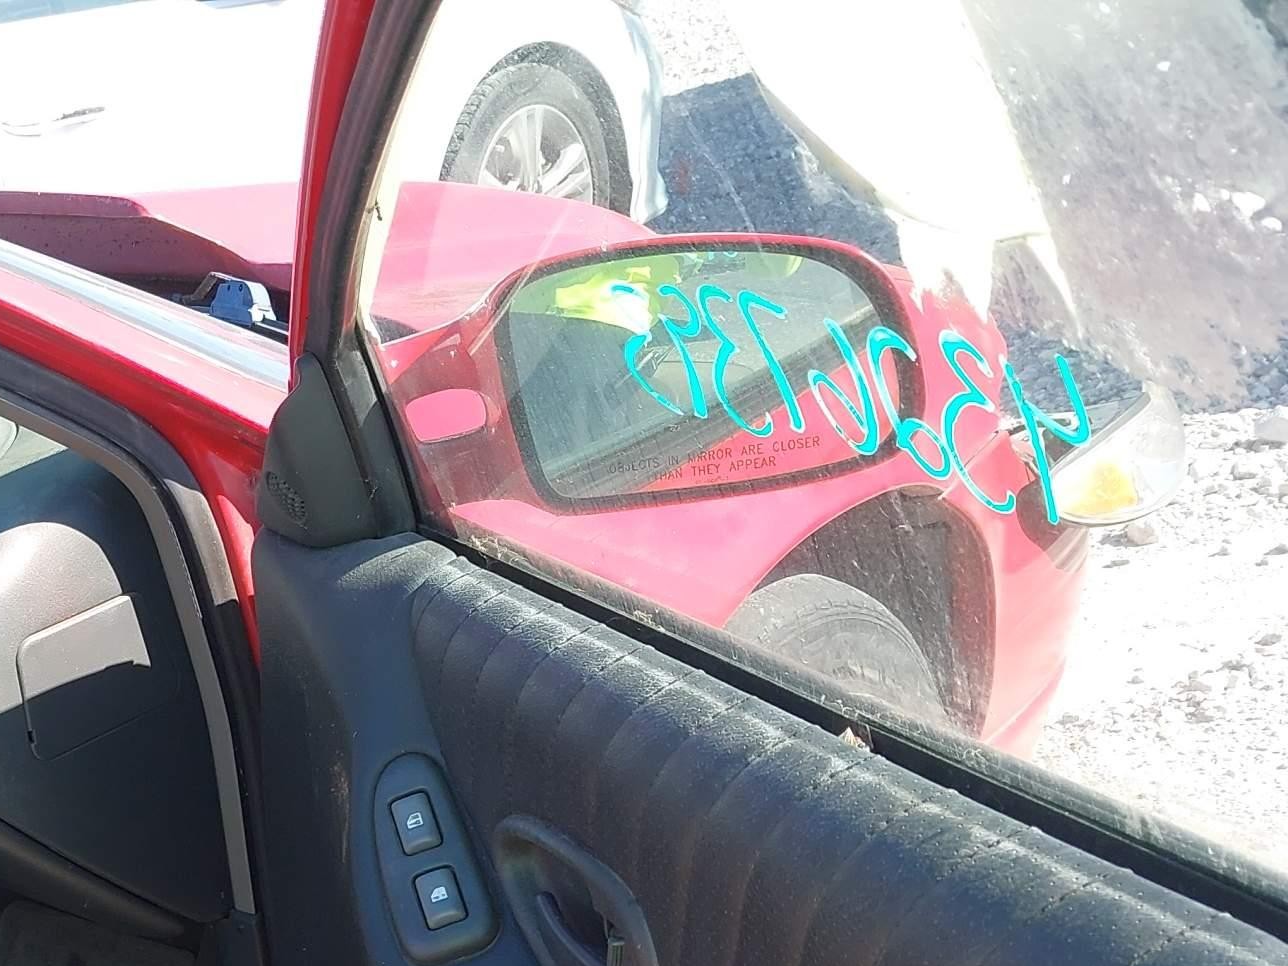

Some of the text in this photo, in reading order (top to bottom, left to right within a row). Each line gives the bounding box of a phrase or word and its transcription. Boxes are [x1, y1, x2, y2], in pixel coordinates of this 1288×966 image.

[607, 436, 821, 474] OBJECTS IN MIRROR ARE CLOSER
[691, 463, 720, 476] THEY
[729, 456, 777, 472] APPEAR
